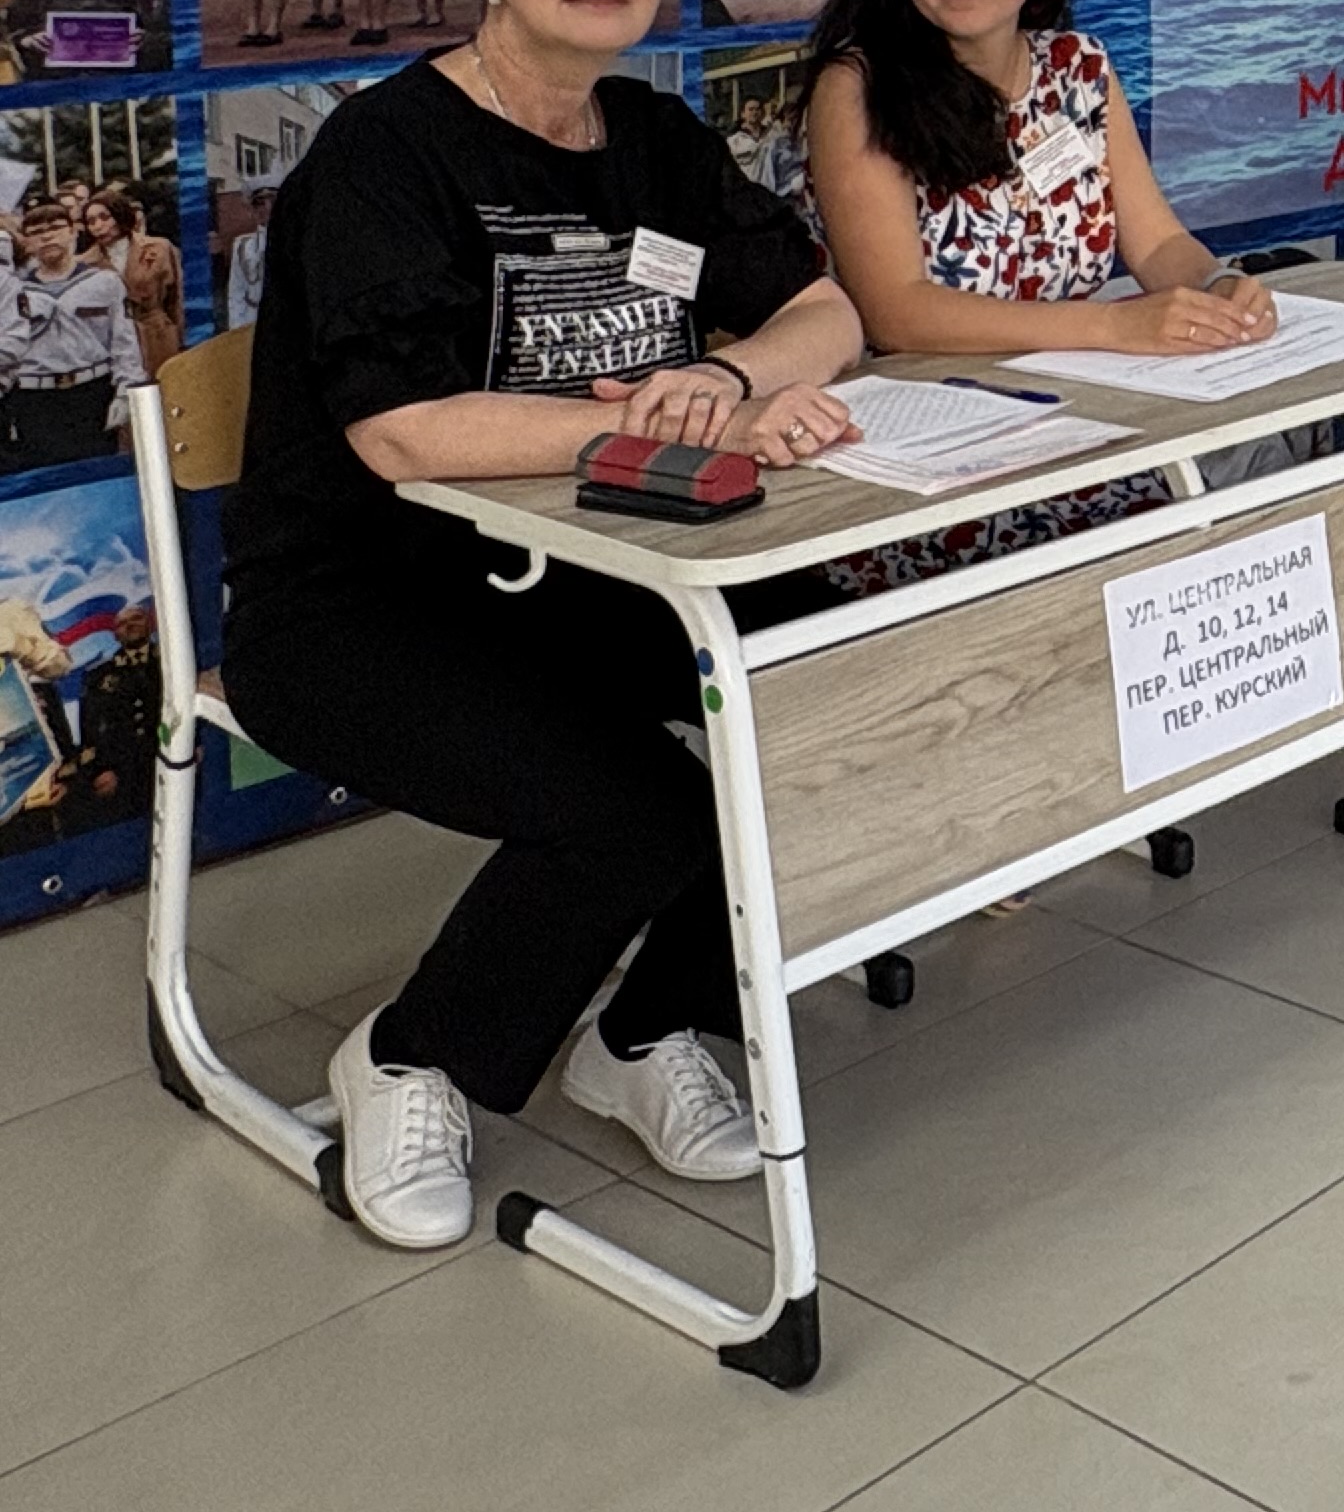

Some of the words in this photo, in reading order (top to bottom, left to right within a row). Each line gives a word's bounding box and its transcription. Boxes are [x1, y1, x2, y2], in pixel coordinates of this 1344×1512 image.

[1125, 598, 1164, 629] УЛ.
[1168, 545, 1313, 616] ЦЕНТРАЛЬНАЯ
[1163, 630, 1187, 661] Д.
[1197, 615, 1228, 644] 10,
[1233, 603, 1262, 631] 12,
[1267, 590, 1289, 618] 14
[1126, 673, 1174, 709] ПЕР.
[1178, 608, 1329, 690] ЦЕНТРАЛЬНЫЙ
[1162, 699, 1211, 735] ПЕР.
[1215, 655, 1307, 713] КУРСКИЙ
